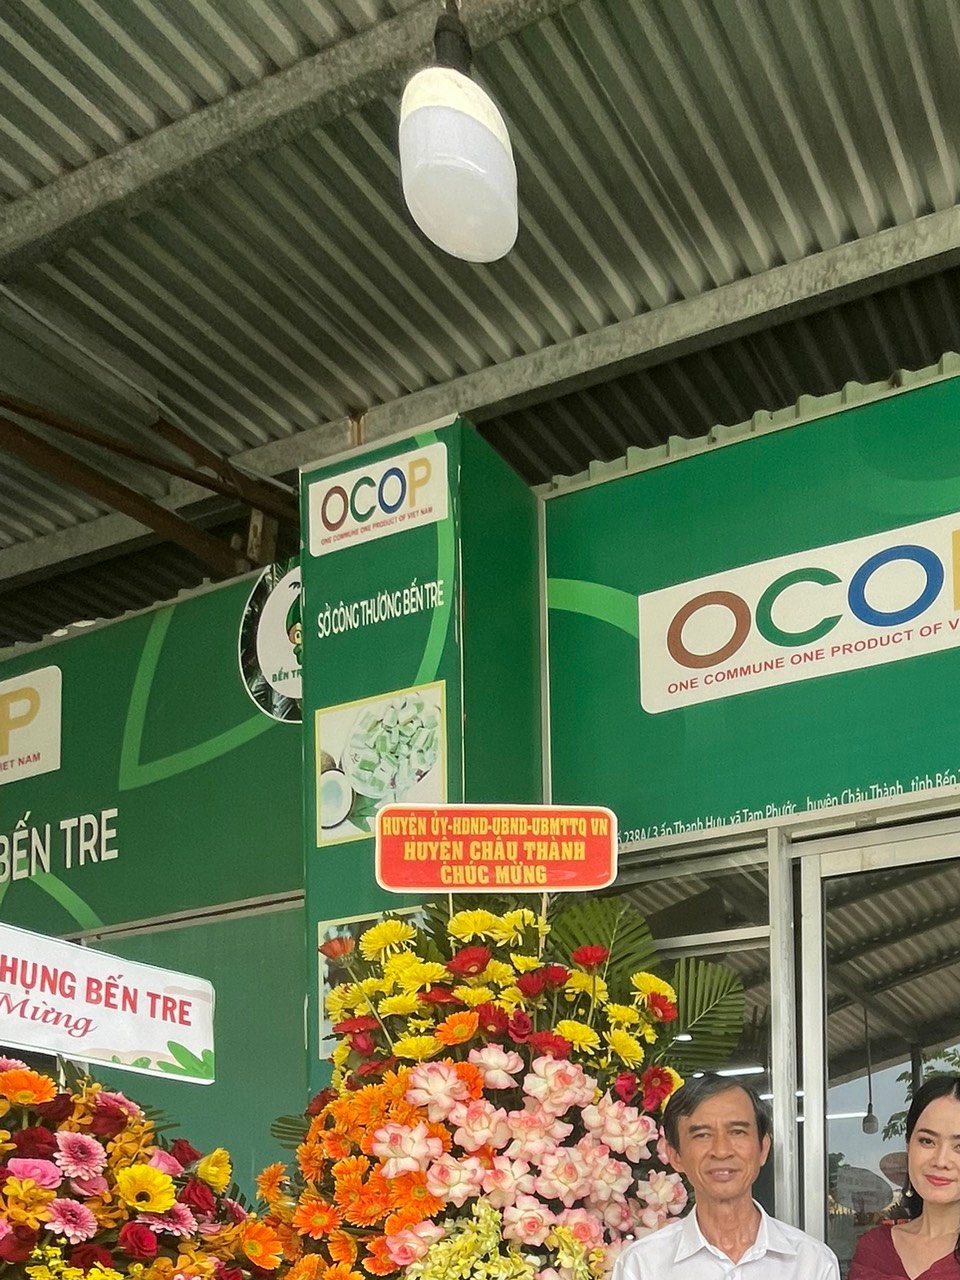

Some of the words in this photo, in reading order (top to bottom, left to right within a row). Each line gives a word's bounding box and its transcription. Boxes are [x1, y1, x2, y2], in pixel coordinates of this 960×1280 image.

[321, 457, 432, 532] OCOP
[318, 602, 331, 638] SỞ
[332, 600, 359, 634] CÔNG
[360, 589, 402, 626] THƯƠNG
[403, 577, 424, 615] BẾN
[424, 580, 444, 609] TRE
[667, 677, 699, 694] ONE
[703, 657, 786, 686] COMMUNE
[790, 648, 825, 666] ONE
[831, 629, 914, 658] PRODUCT
[919, 622, 943, 638] OF
[18, 752, 41, 766] NAM
[0, 811, 50, 883] BẾN
[60, 808, 119, 869] TRE
[404, 836, 464, 864] HUYỆN
[469, 836, 518, 861] CHÂU
[523, 836, 586, 861] THÀNH
[591, 817, 608, 836] VN
[440, 860, 490, 884] CHÚC
[494, 861, 548, 884] MỪNG
[0, 954, 77, 1001] HỤNG
[85, 975, 139, 1014] BẾN
[146, 992, 193, 1026] TRE
